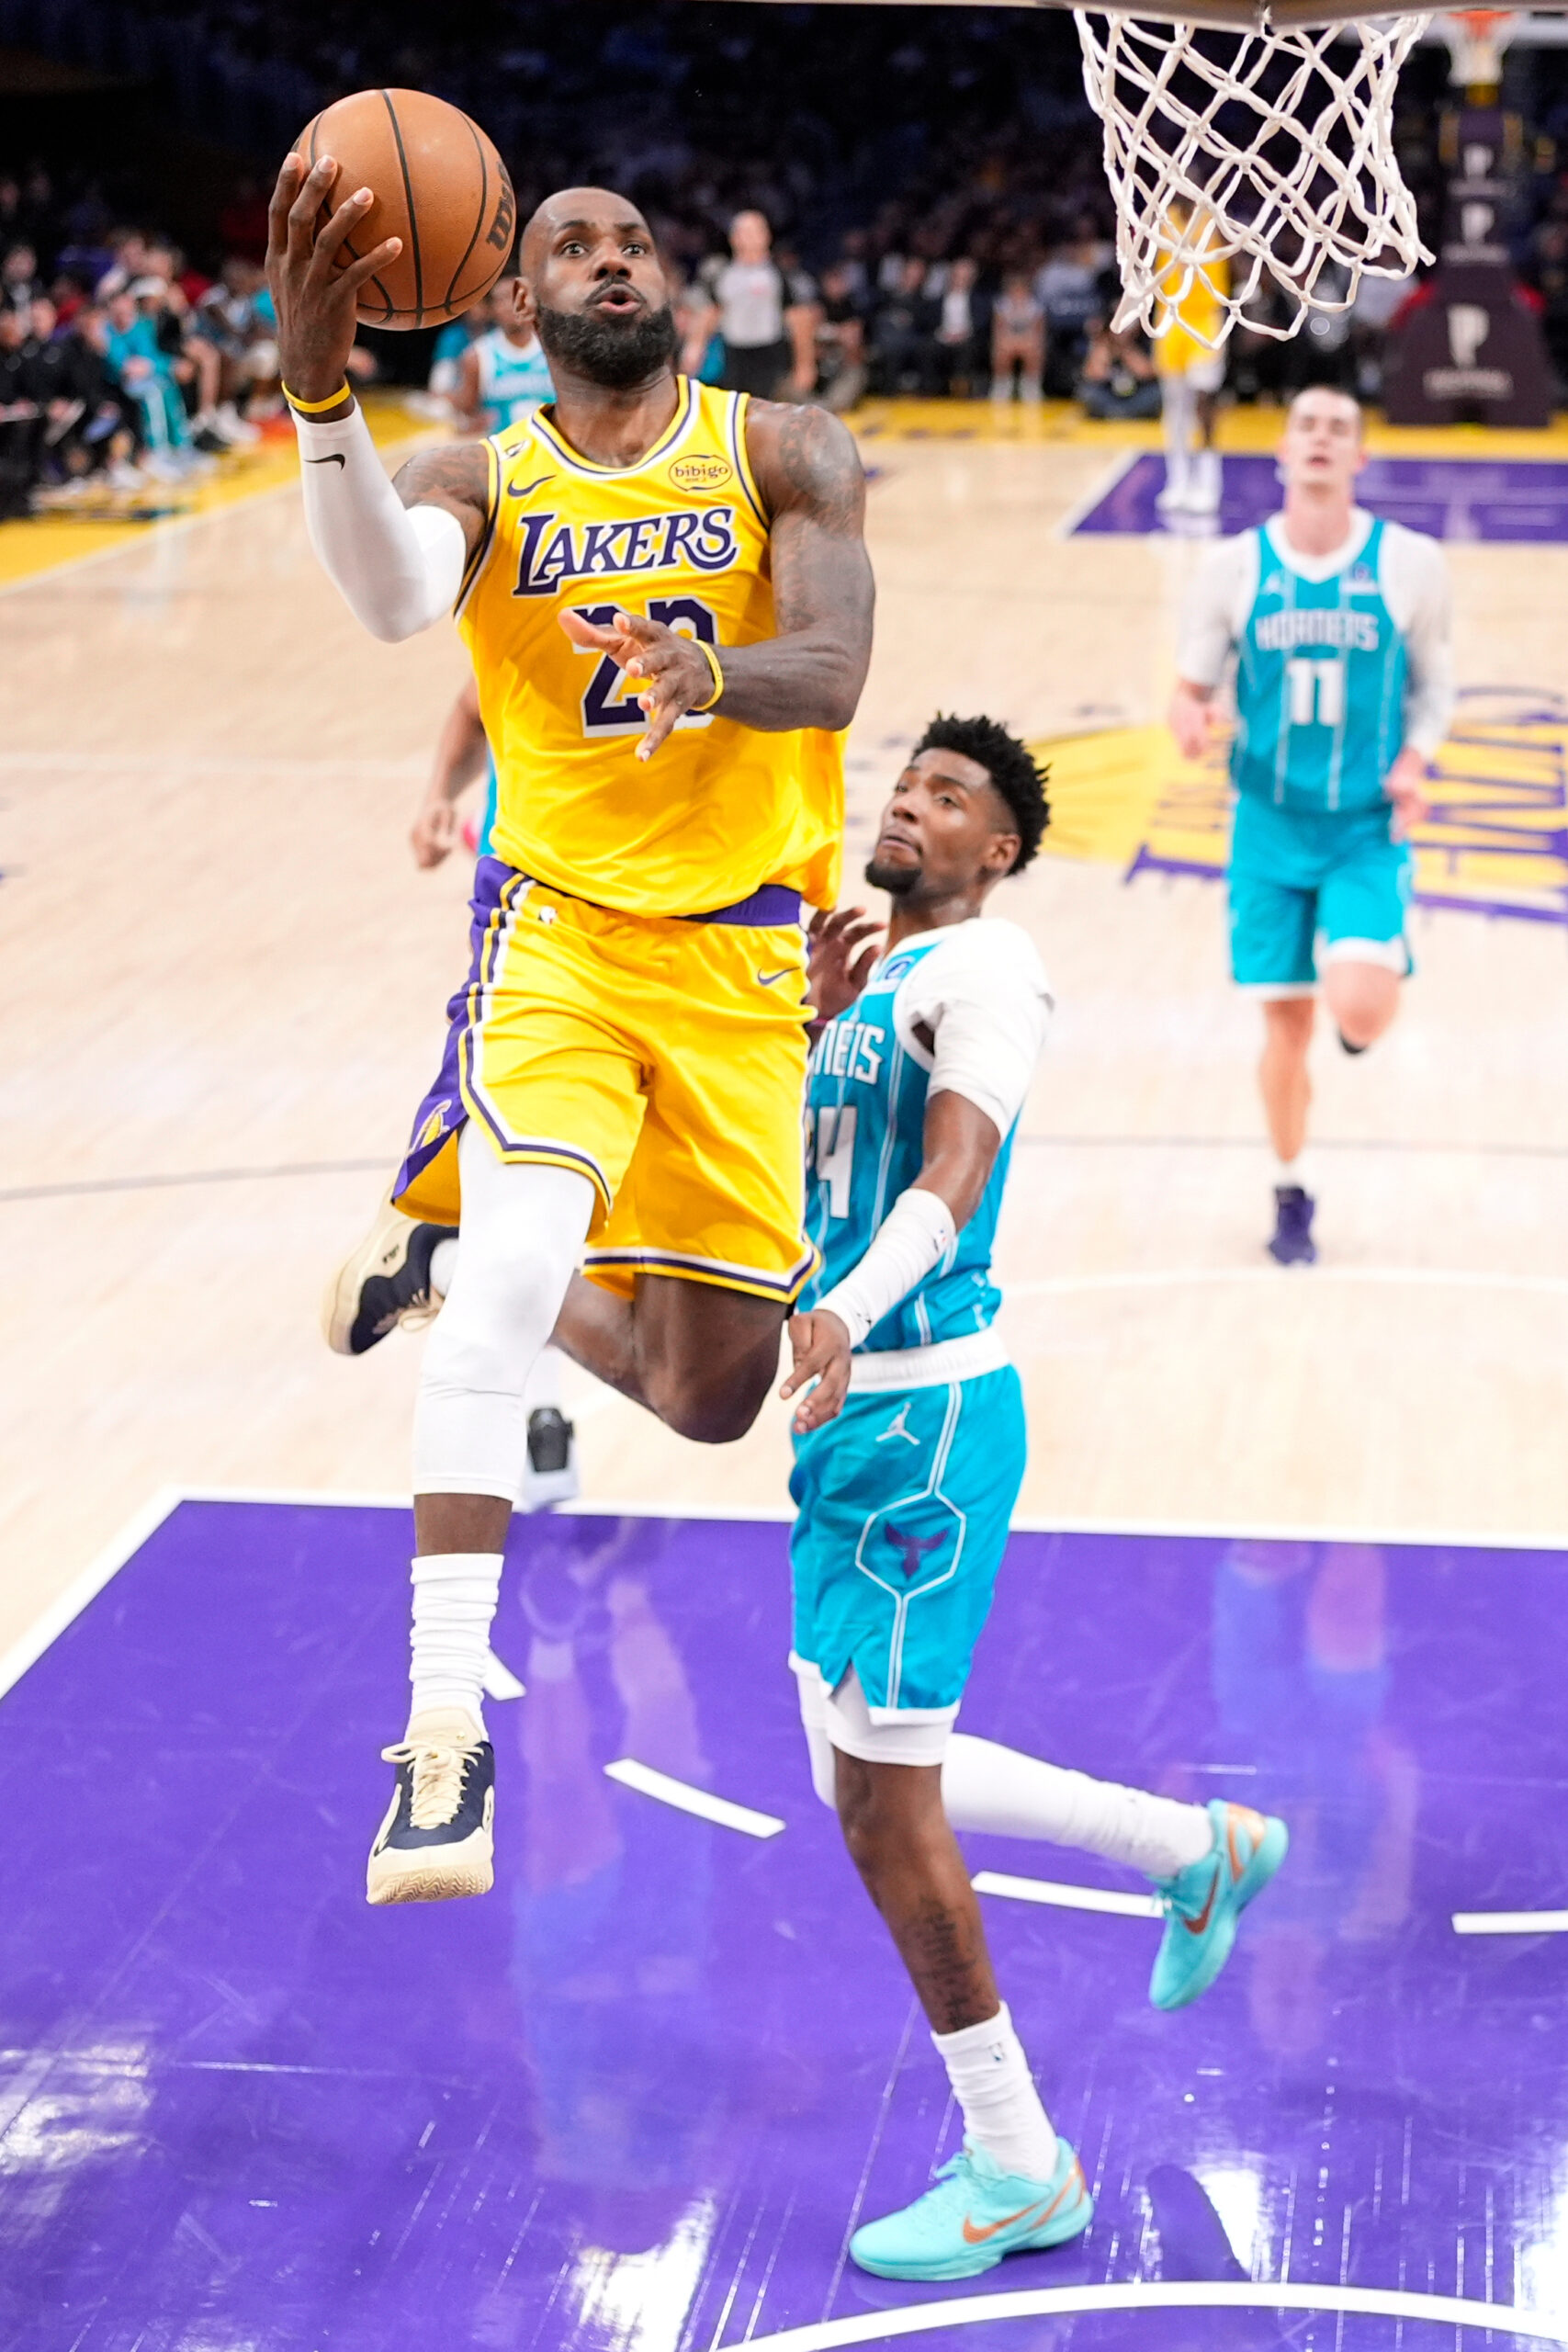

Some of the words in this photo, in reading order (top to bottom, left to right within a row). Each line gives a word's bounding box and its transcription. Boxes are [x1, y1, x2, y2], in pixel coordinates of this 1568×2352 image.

[675, 464, 728, 479] bibigo
[512, 504, 739, 597] LAKERS
[1288, 659, 1345, 728] 11
[807, 1019, 886, 1085] NETS
